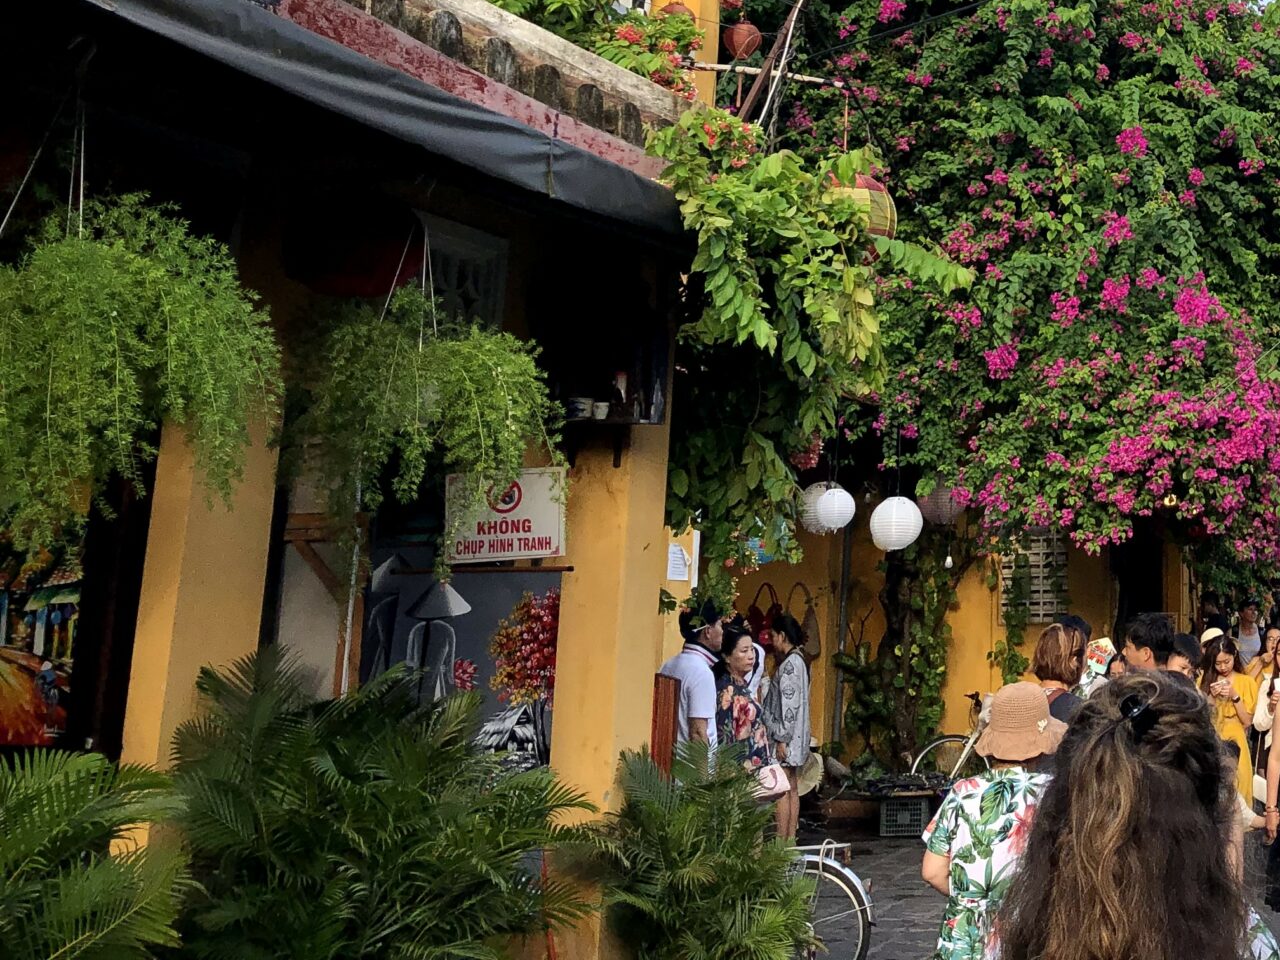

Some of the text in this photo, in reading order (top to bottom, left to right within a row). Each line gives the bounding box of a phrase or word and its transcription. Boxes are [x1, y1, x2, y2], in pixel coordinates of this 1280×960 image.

[477, 517, 532, 536] KHÔNG
[455, 535, 552, 559] CHỤP HÌNH TRANH
